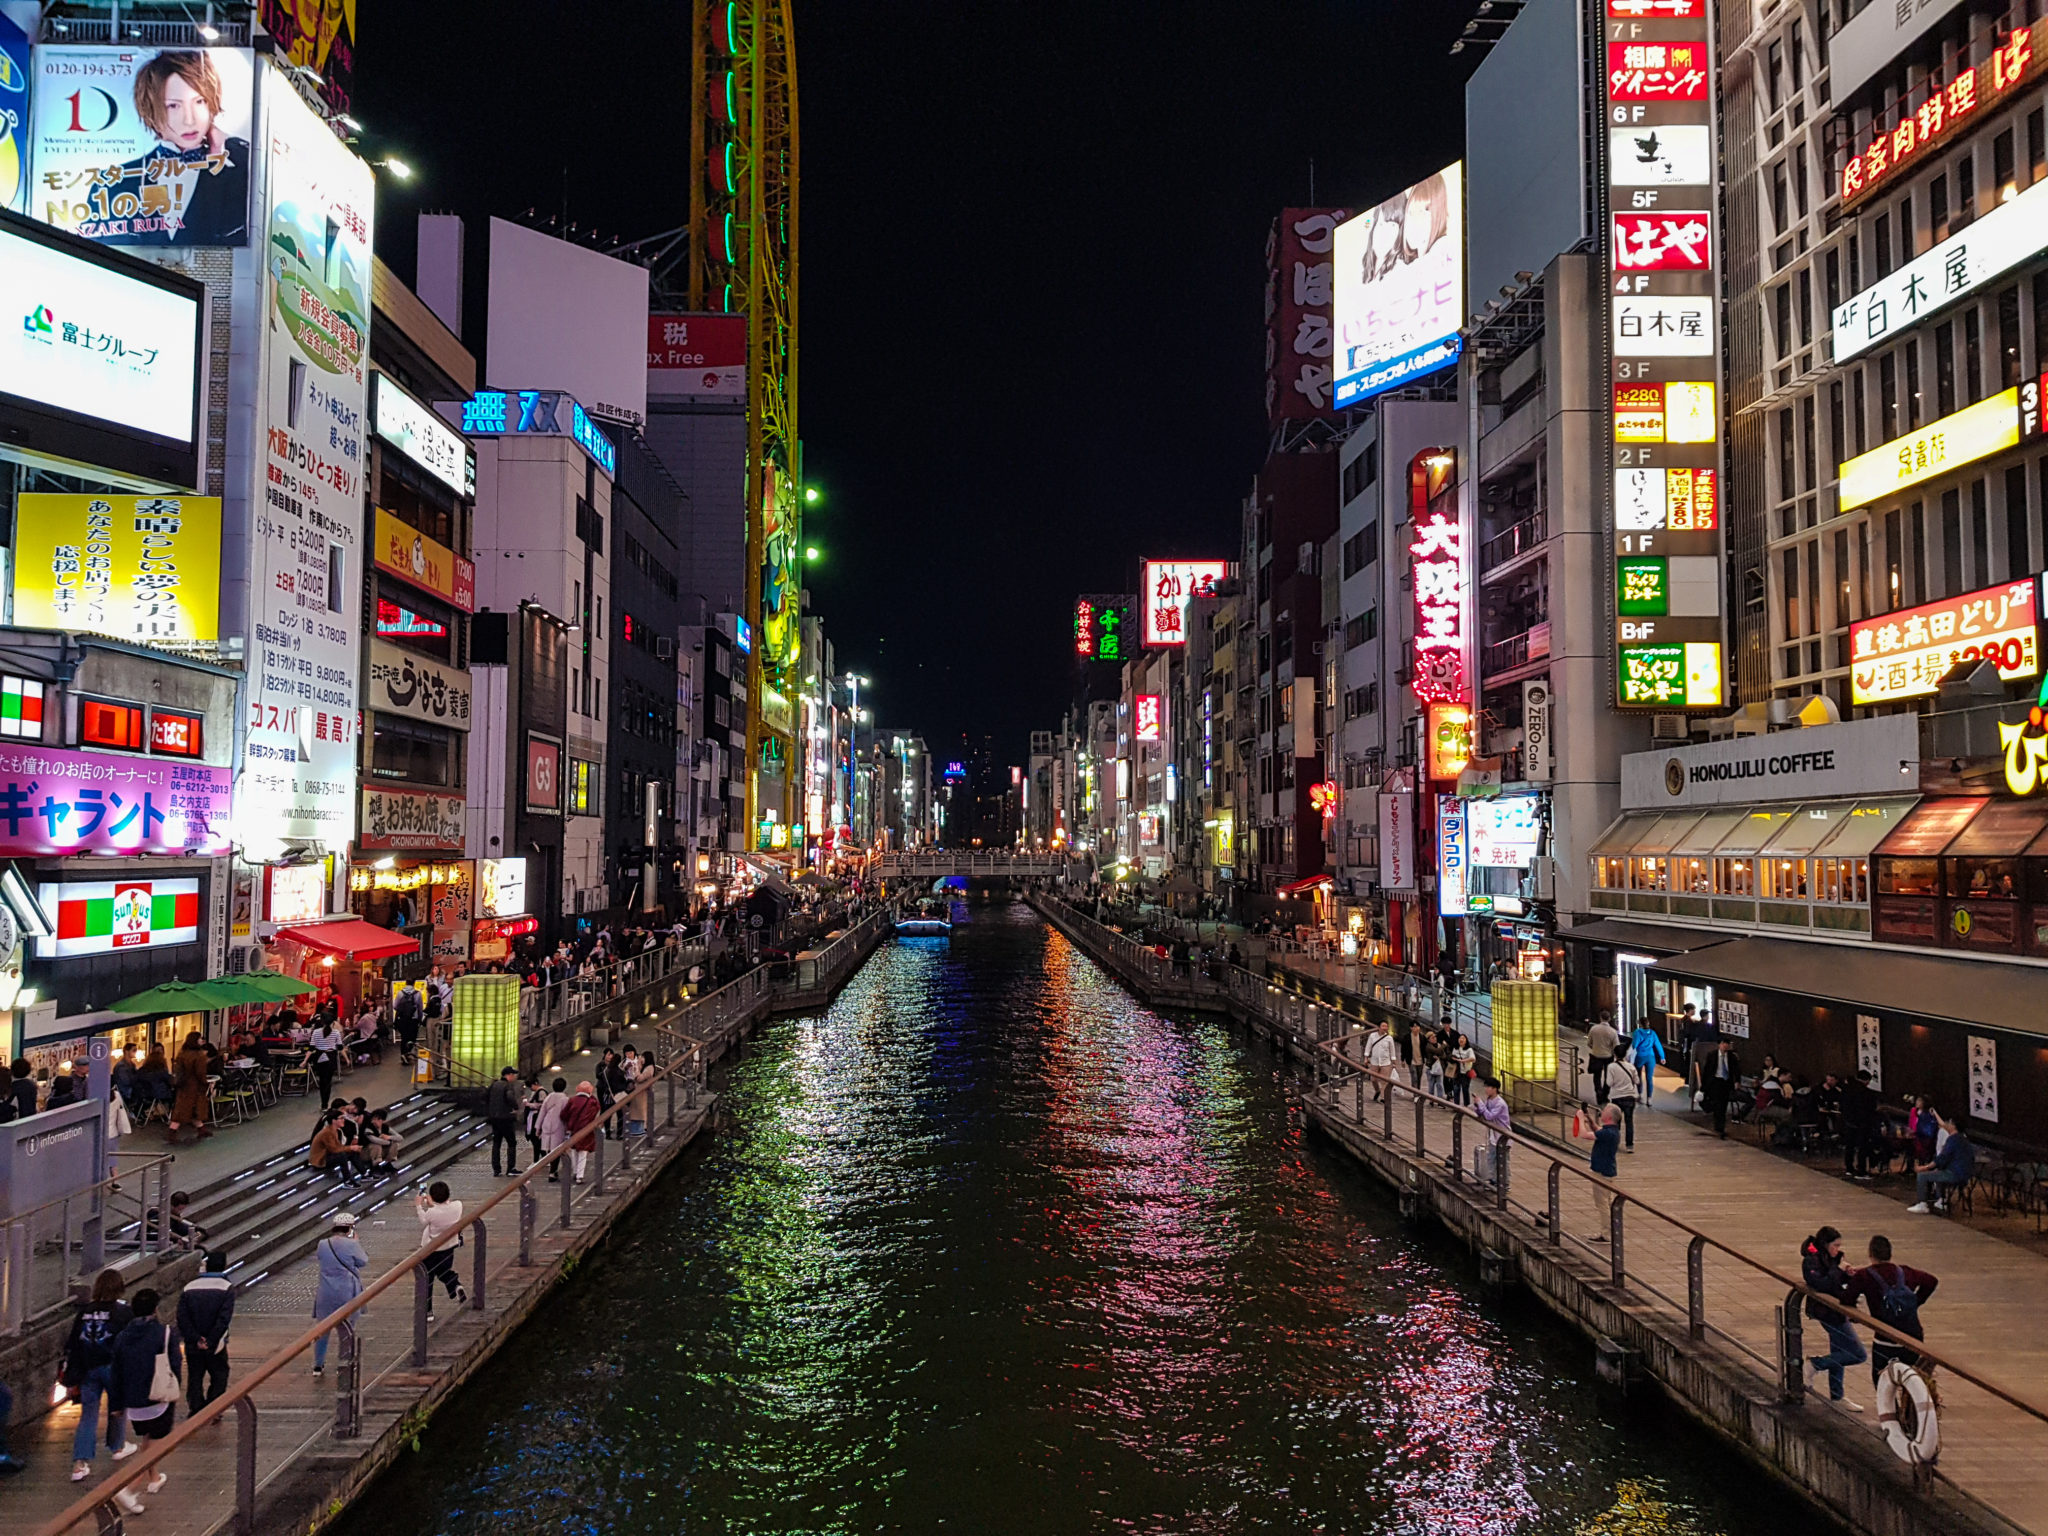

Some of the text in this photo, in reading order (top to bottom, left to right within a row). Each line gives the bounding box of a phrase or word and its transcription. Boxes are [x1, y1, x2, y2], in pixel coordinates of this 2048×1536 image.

[1612, 24, 1643, 38] 7F
[1624, 46, 1665, 68] 相席
[1611, 69, 1705, 95] ダイニング
[1613, 106, 1645, 122] 6F
[1843, 67, 1976, 197] 民芸肉料理
[43, 152, 230, 191] モンスターグループ
[1632, 191, 1658, 207] 5F
[134, 217, 186, 232] RUKA
[1616, 276, 1649, 292] 4F
[1839, 244, 1971, 340] 4F 白木屋
[664, 322, 688, 346] 税
[1620, 307, 1705, 337] 白木屋
[62, 322, 159, 365] 富士グループ
[647, 351, 705, 364] ax Free
[1619, 363, 1650, 378] 3F
[2022, 382, 2038, 435] 3F
[1620, 449, 1651, 464] 2F
[298, 525, 325, 555] 5,200円
[1622, 535, 1653, 552] 1F
[84, 500, 112, 623] あなたのお店づくり
[53, 545, 80, 613] 応援します
[275, 568, 324, 598] 土日祝 7,800円
[1625, 571, 1660, 587] びっくり
[1624, 586, 1661, 600] ドンキー
[1078, 602, 1091, 652] お好み焼
[1622, 623, 1655, 639] B1F
[1854, 582, 2033, 660] 豊後高田どり 2F
[318, 623, 347, 646] 3,780円
[298, 659, 312, 677] 平日
[1626, 658, 1679, 680] びっくり
[297, 681, 312, 699] 平日
[387, 657, 448, 717] うなぎ
[1624, 679, 1684, 701] ドンキー
[152, 720, 188, 747] たばこ
[251, 703, 351, 744] コスパ 最高!
[1529, 707, 1542, 771] ZERO cafe
[535, 756, 551, 792] G3
[1690, 750, 1835, 783] HONOLULU COFFEE
[170, 780, 229, 795] 06-6212-3013
[0, 781, 165, 839] ギャラント
[386, 795, 440, 833] お好み焼
[391, 837, 436, 847] OKONOMIYAKI
[1444, 818, 1461, 868] ダイコク
[40, 1125, 83, 1149] information
